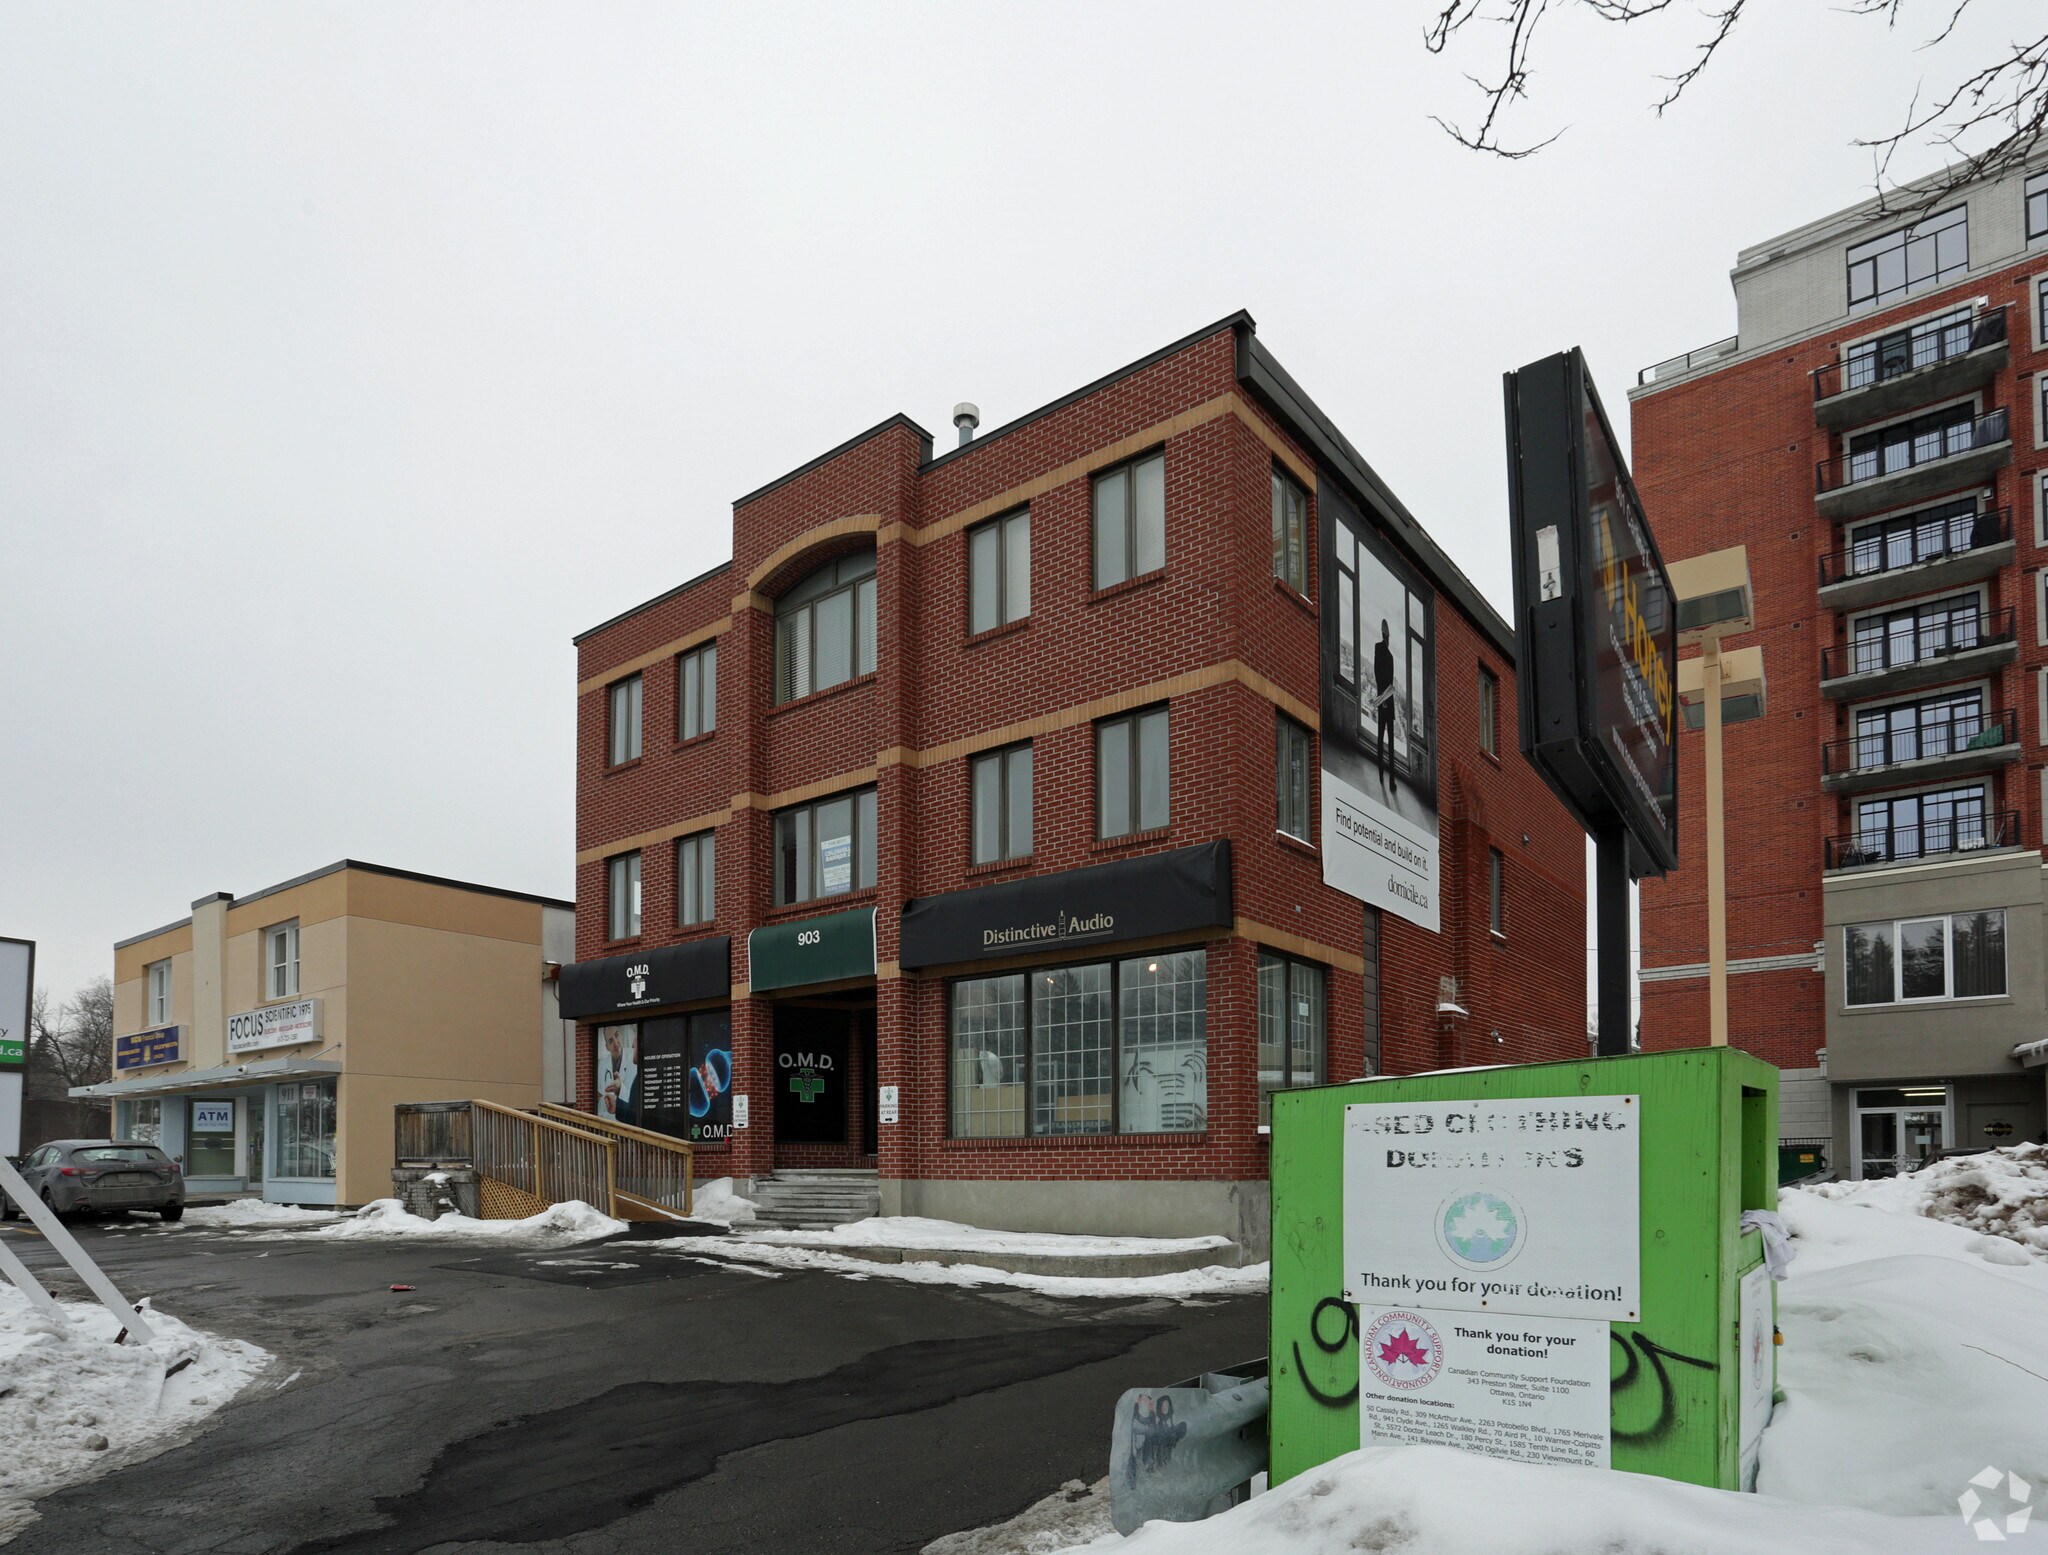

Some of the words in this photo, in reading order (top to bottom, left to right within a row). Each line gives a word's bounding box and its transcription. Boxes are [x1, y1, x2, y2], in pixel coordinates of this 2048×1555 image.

[1624, 559, 1673, 746] Honey
[1336, 808, 1352, 829] Find
[1354, 821, 1382, 847] potential
[1384, 838, 1396, 854] and
[1398, 843, 1412, 863] build
[1414, 855, 1422, 867] on
[1388, 874, 1428, 909] domicile.ca
[798, 930, 820, 946] 903
[984, 924, 1056, 945] Distinctive
[1068, 914, 1114, 933] Audio
[626, 964, 650, 978] O.M.D.
[265, 1006, 296, 1023] SCIENTIFIC
[299, 1003, 311, 1016] 1975
[230, 1013, 263, 1040] FOCUS
[778, 1052, 834, 1071] O.M.D.
[281, 1089, 294, 1100] 911
[198, 1112, 228, 1121] ATM
[1352, 1113, 1434, 1134] SED
[1361, 1273, 1411, 1289] Thank
[1416, 1279, 1447, 1292] you
[1451, 1278, 1474, 1292] for
[1480, 1282, 1522, 1296] your
[1378, 1313, 1431, 1331] COMMUNITY
[1454, 1327, 1492, 1340] Thank
[1496, 1332, 1519, 1342] you
[1523, 1332, 1542, 1343] for
[1546, 1336, 1576, 1346] your
[1366, 1326, 1378, 1371] CANADIAN
[1430, 1332, 1442, 1374] SUPPORT
[1487, 1344, 1548, 1358] donation!
[1376, 1370, 1432, 1389] FOUNDATION
[1448, 1367, 1478, 1376] Canadian
[1480, 1370, 1518, 1381] Community
[1521, 1374, 1548, 1384] Support
[1551, 1377, 1591, 1387] Foundation
[1482, 1379, 1506, 1388] Preston
[1387, 1395, 1418, 1404] donation
[1420, 1399, 1455, 1408] locations:
[1490, 1389, 1516, 1398] Ottawa,
[1519, 1392, 1545, 1400] Ontario
[1376, 1406, 1399, 1416] Cassidy
[1428, 1413, 1459, 1422] McArthur
[1460, 1417, 1476, 1425] Ave.,
[1478, 1419, 1495, 1427] 2263
[1531, 1425, 1550, 1435] Blvd.,
[1573, 1431, 1604, 1440] Merivale
[1396, 1417, 1414, 1426] Clyde
[1415, 1420, 1431, 1428] Ave.,
[1450, 1424, 1476, 1434] Walkley
[1545, 1436, 1601, 1449] Warner-Colpitts
[1390, 1432, 1405, 1440] Ave.,
[1420, 1437, 1446, 1446] Bayview
[1448, 1441, 1465, 1449] Ave.,
[1467, 1443, 1483, 1451] 2040
[1485, 1446, 1509, 1455] Ogilvie
[1510, 1449, 1524, 1458] Rd.,
[1542, 1453, 1582, 1465] Viewmount
[1403, 1426, 1424, 1435] Doctor
[1426, 1429, 1444, 1437] Leach
[1474, 1436, 1492, 1445] Percy
[1495, 1438, 1506, 1446] St.,
[1509, 1440, 1526, 1448] 1585
[1528, 1442, 1549, 1452] Tenth
[1551, 1446, 1566, 1454] Line
[1568, 1447, 1583, 1456] Rd.,
